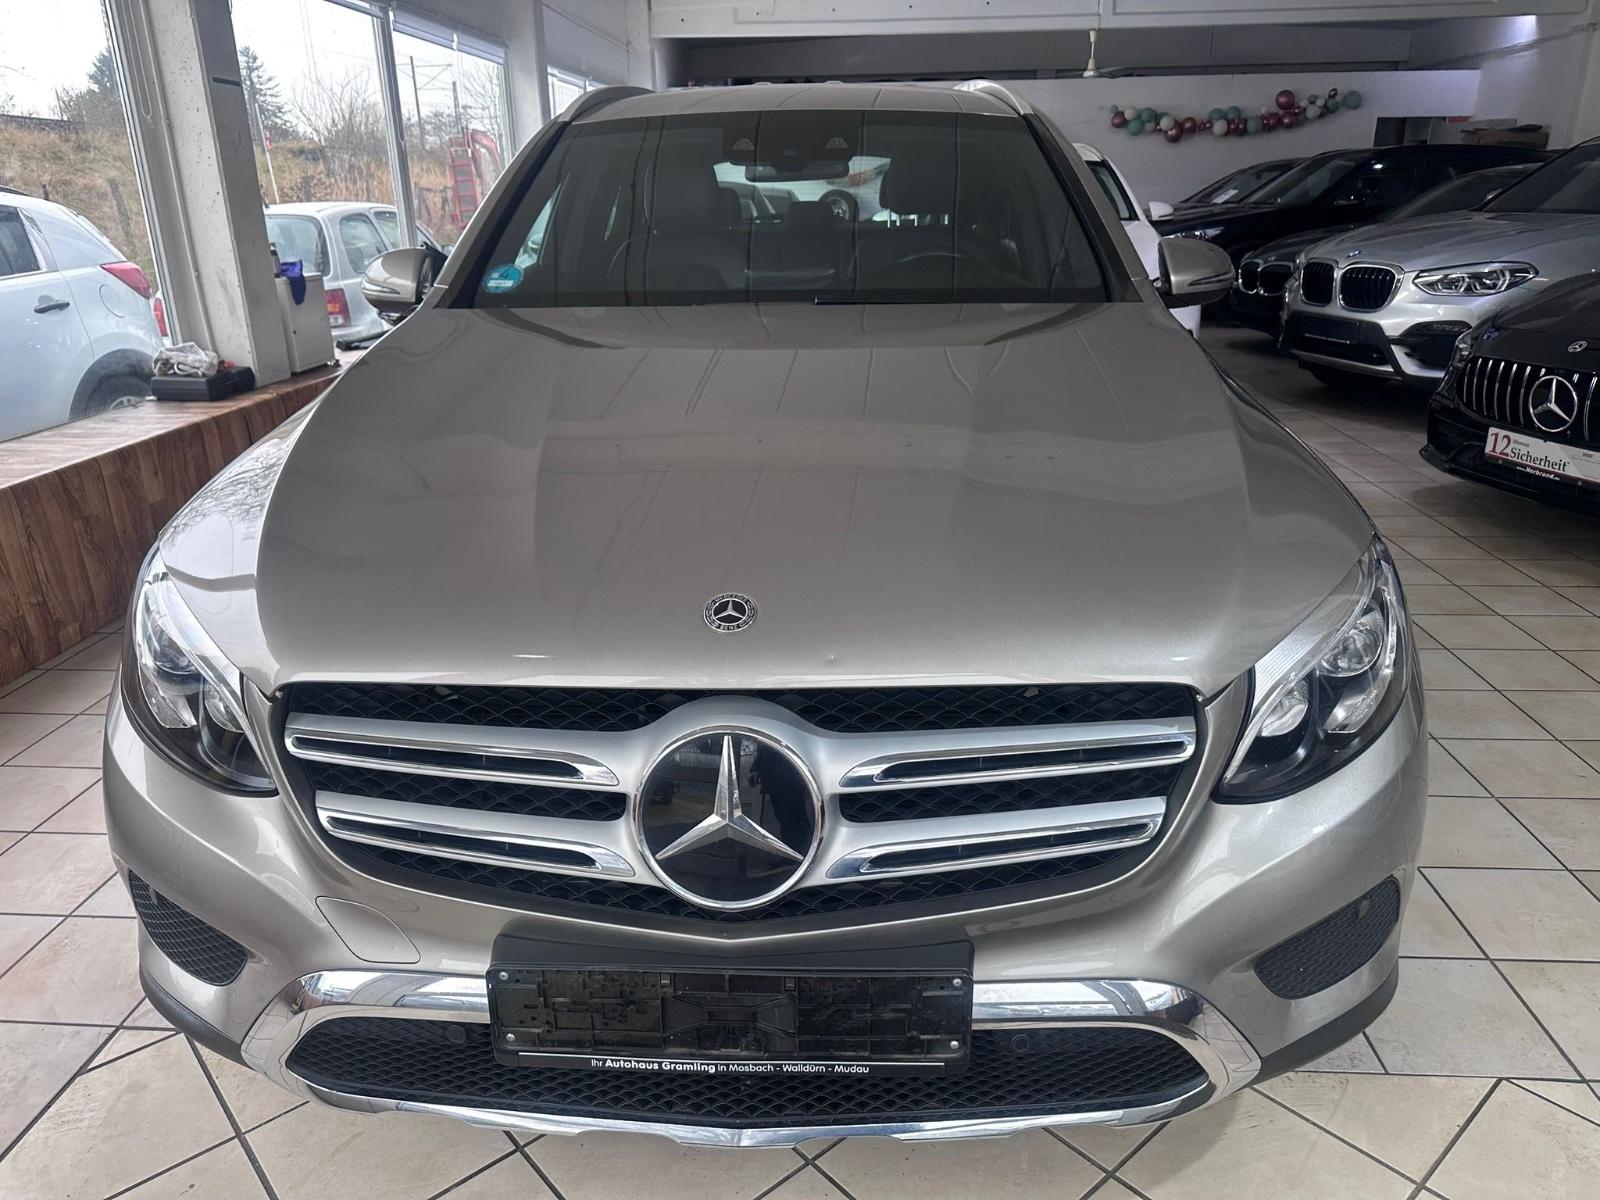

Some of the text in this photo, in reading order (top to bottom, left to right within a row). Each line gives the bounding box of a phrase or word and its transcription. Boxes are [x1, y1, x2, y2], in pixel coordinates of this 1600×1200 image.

[1489, 432, 1511, 457] 12
[591, 1059, 603, 1067] Ihr
[605, 1059, 659, 1070] Autohaus
[662, 1062, 716, 1073] Gramling
[728, 1064, 774, 1072] Mosbach
[782, 1064, 826, 1072] Walldürn
[834, 1065, 869, 1073] Mudau
